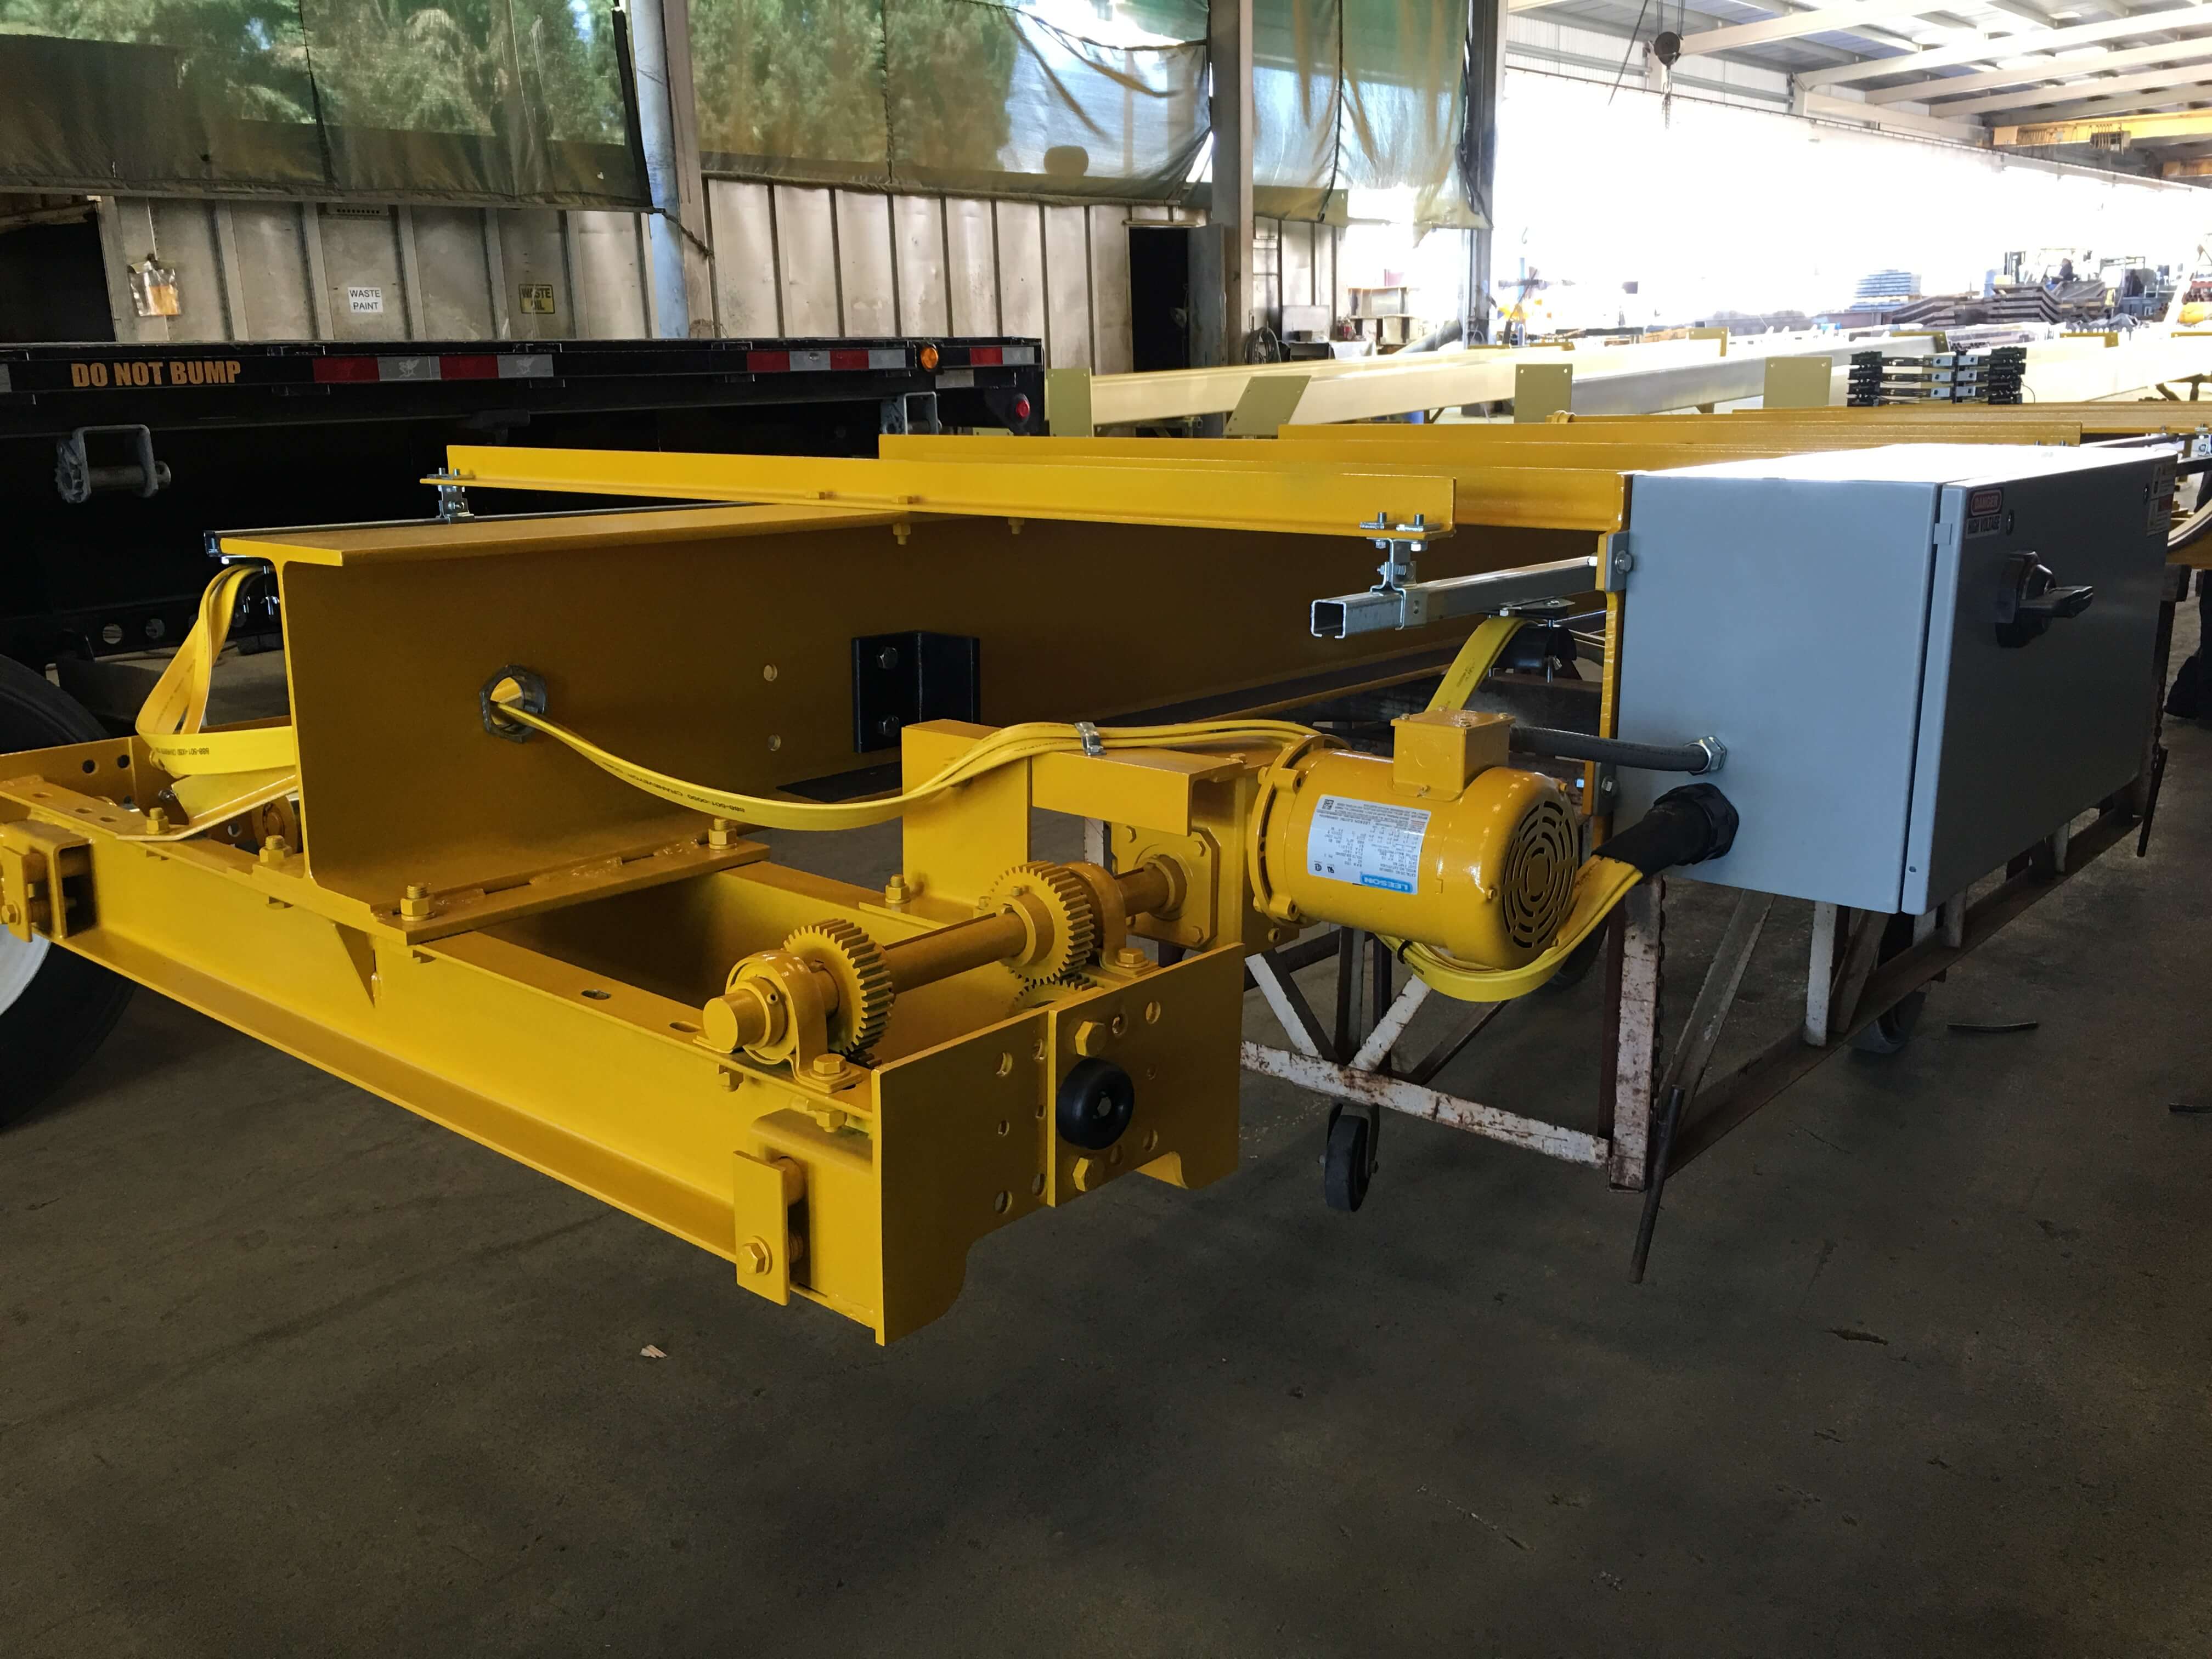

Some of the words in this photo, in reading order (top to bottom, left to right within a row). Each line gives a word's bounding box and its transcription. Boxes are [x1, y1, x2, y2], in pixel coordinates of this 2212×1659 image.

[349, 289, 381, 298] WASTE
[353, 302, 378, 311] PAINT
[71, 363, 108, 387] DO
[114, 362, 163, 386] NOT
[170, 360, 241, 385] BUMP
[1974, 495, 1998, 510] DANGER
[1980, 516, 1999, 532] VOLTAGE
[1363, 877, 1409, 890] LEESON
